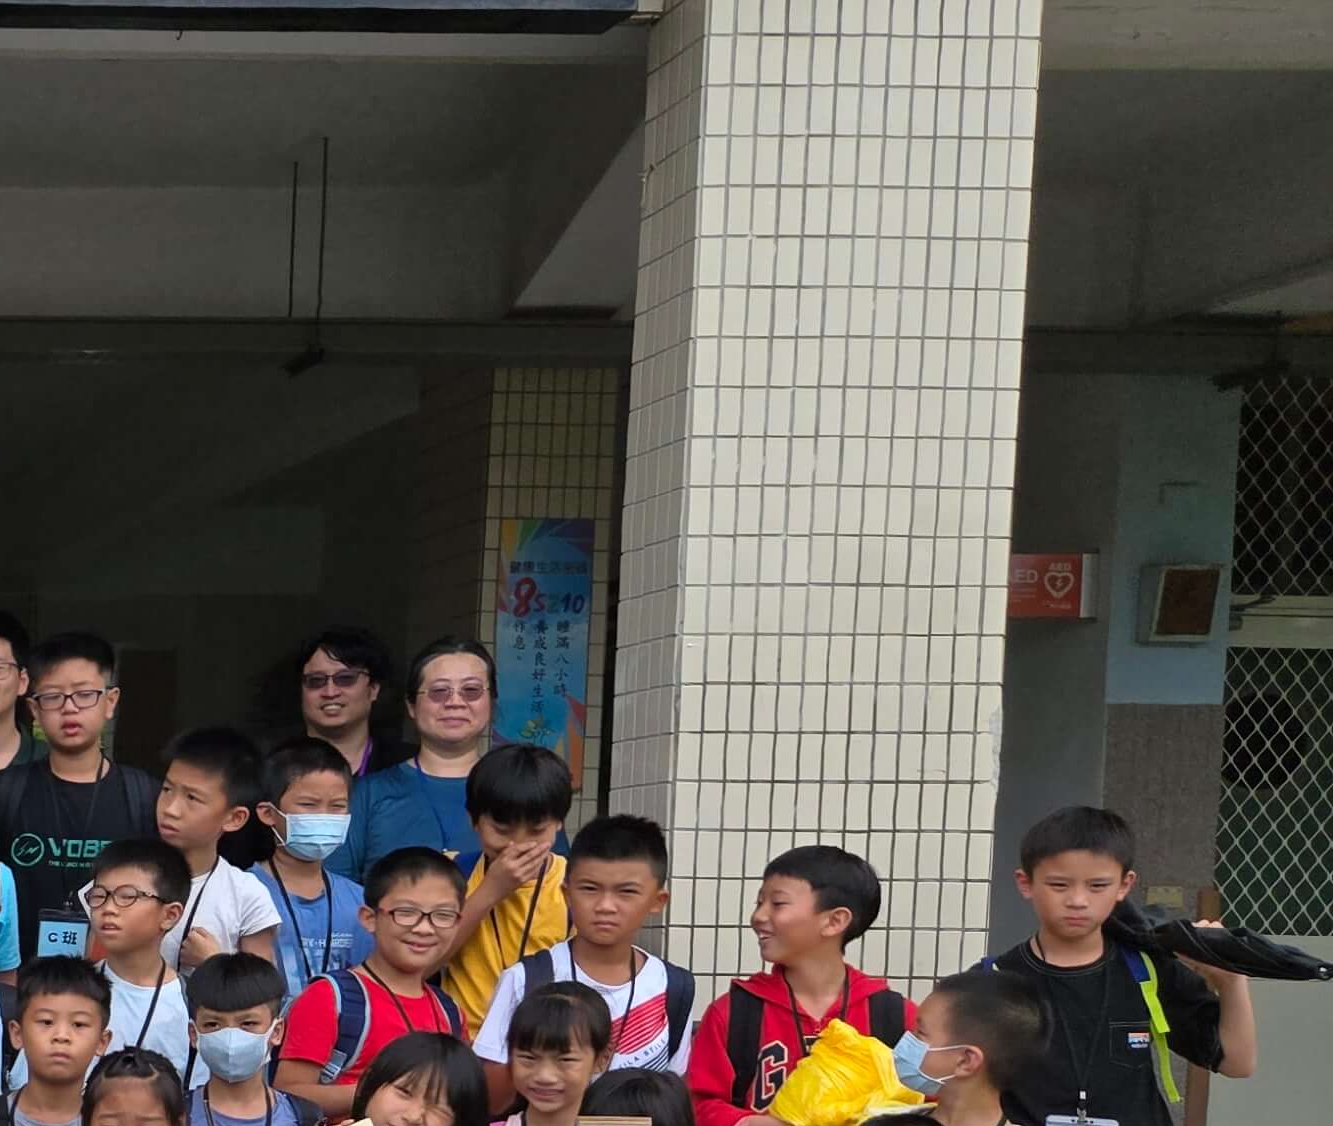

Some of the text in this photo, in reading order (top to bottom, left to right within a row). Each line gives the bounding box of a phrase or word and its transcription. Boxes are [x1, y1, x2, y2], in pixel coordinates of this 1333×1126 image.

[1012, 568, 1038, 584] ED
[47, 931, 78, 945] C 班
